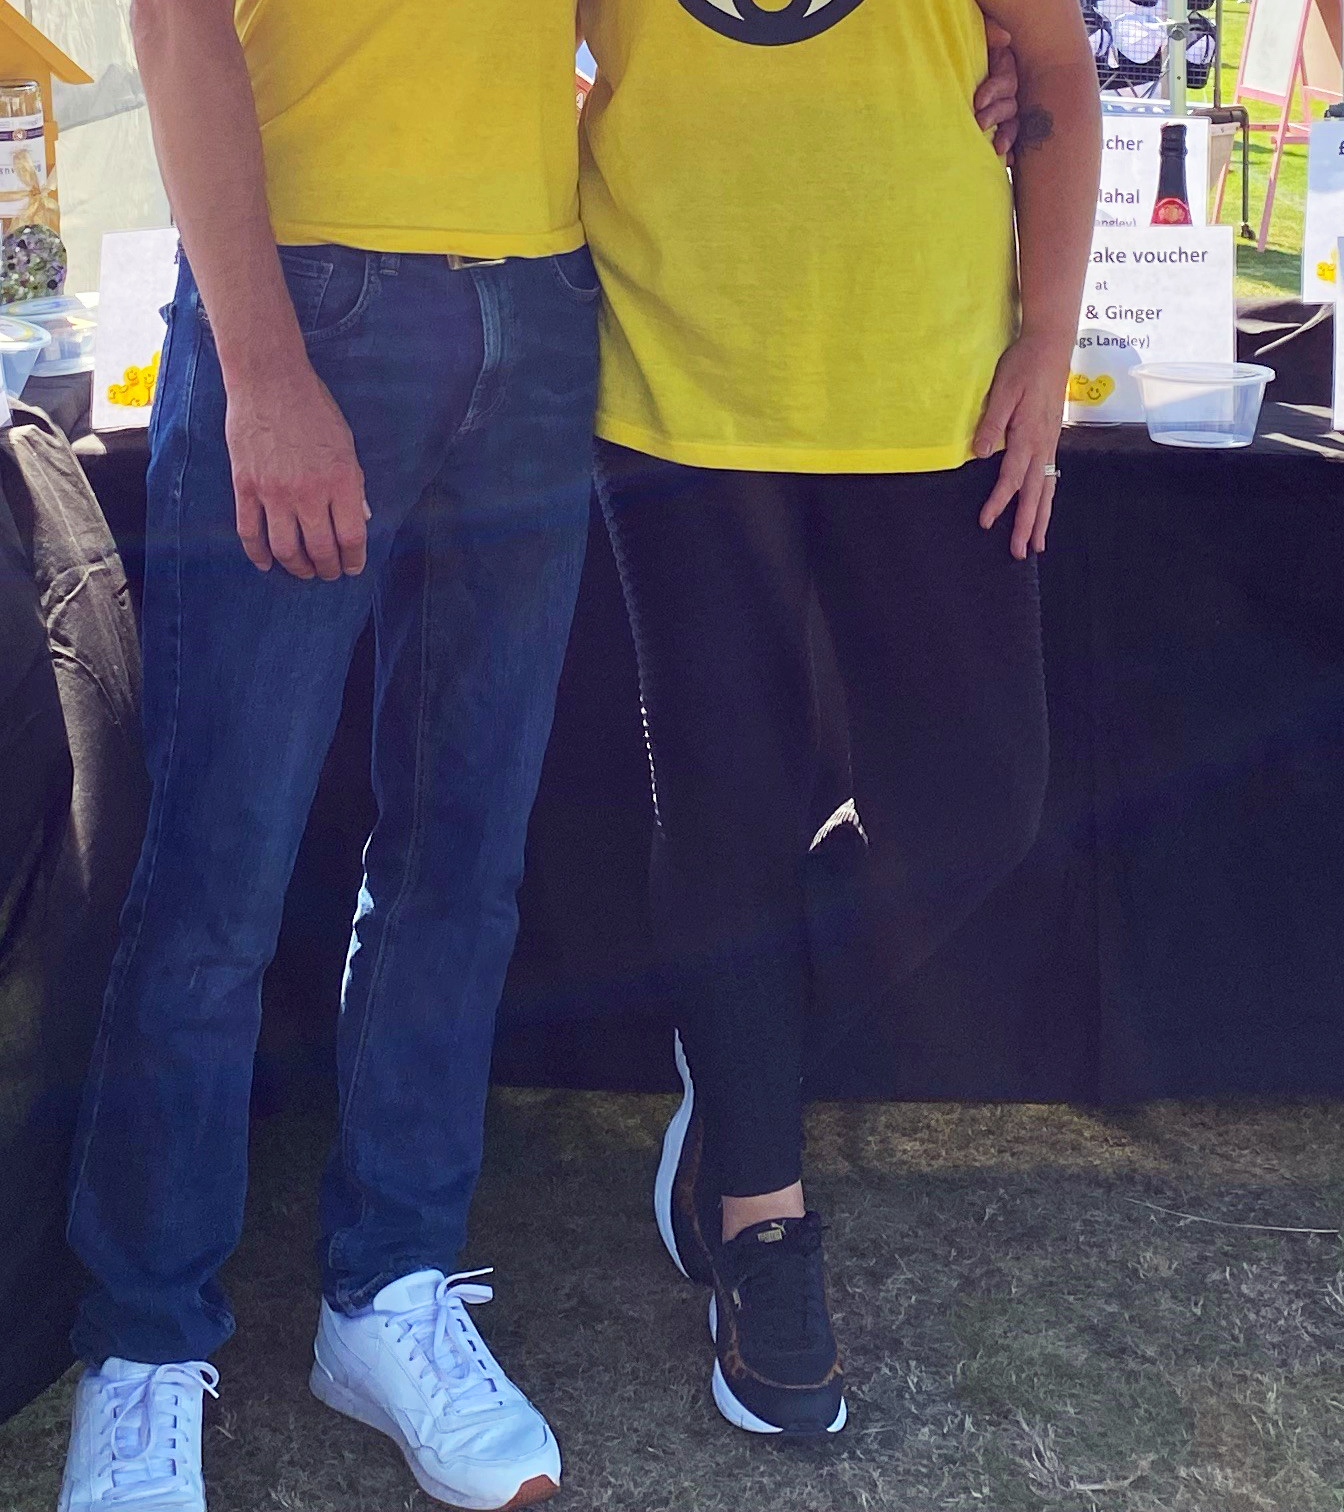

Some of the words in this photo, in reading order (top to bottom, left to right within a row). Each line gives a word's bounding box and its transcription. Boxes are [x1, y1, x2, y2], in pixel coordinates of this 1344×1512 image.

[1102, 134, 1144, 151] cher
[1088, 246, 1127, 264] ake
[1132, 246, 1209, 264] voucher
[1095, 280, 1109, 291] at
[1086, 304, 1099, 320] &
[1105, 305, 1163, 323] Ginger
[1096, 334, 1150, 349] Langley)
